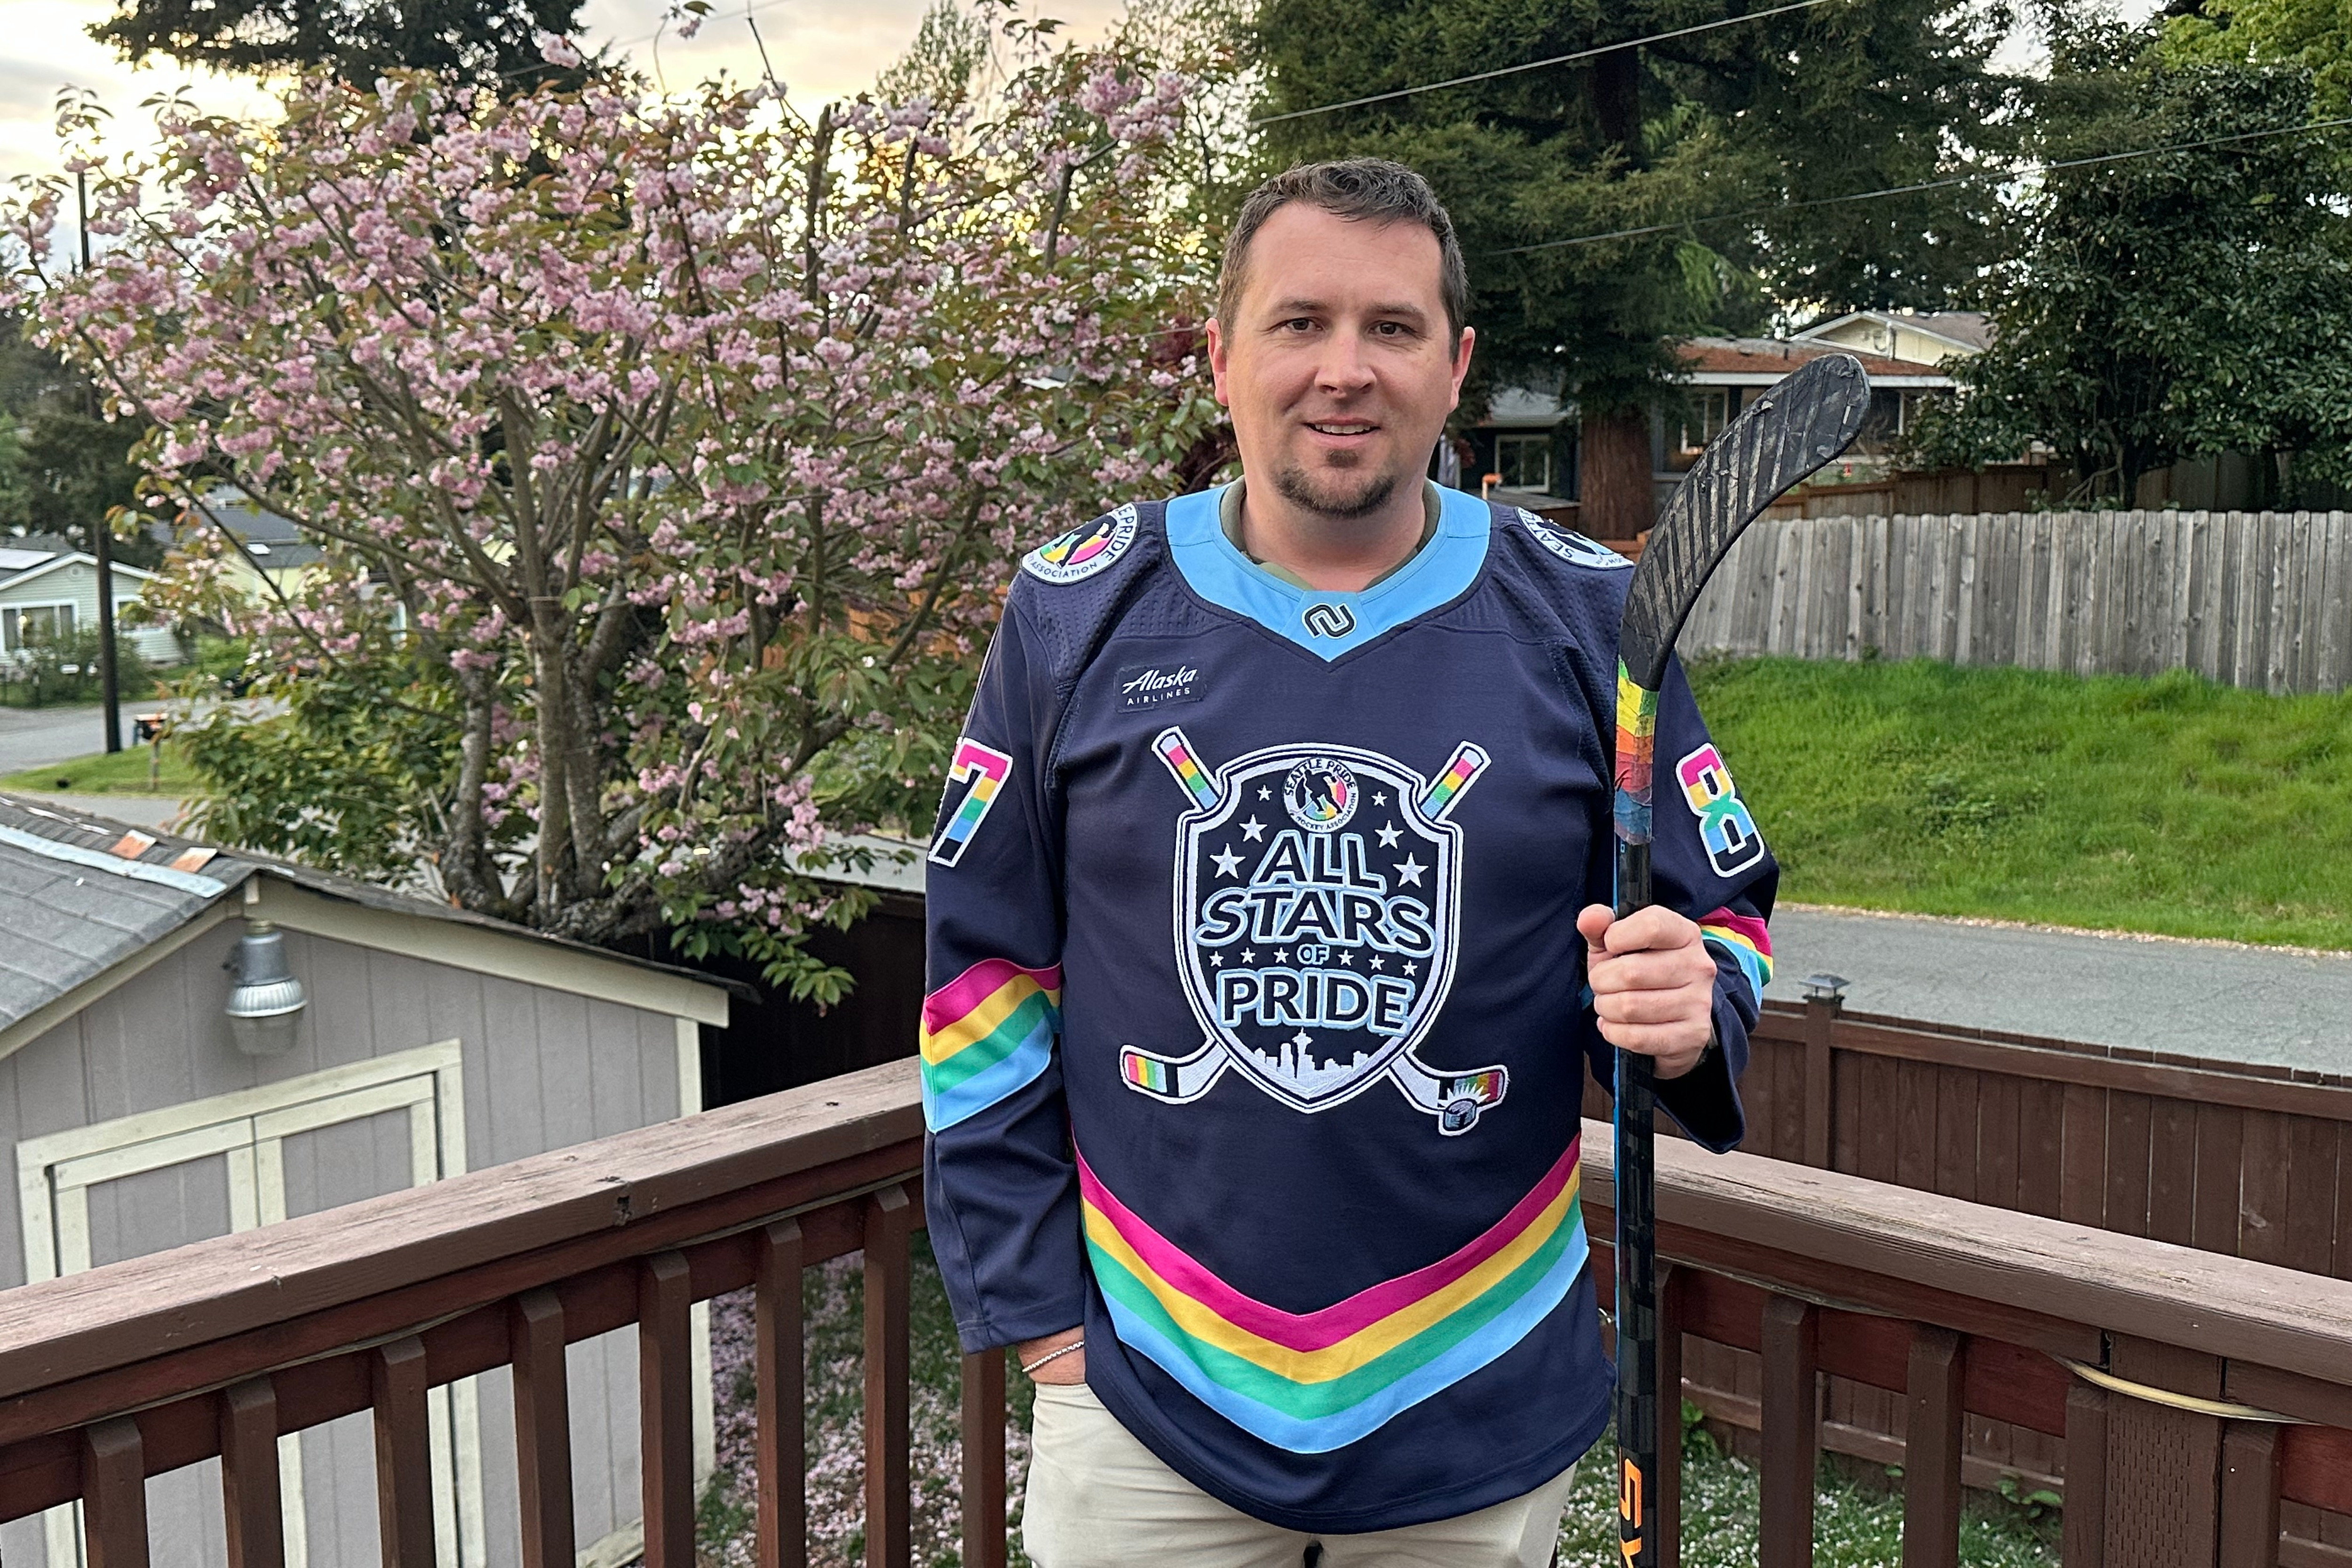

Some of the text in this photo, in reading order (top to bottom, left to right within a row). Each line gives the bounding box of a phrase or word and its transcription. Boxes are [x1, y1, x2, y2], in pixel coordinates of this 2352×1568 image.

[1101, 516, 1135, 561] PRIDE
[1030, 561, 1097, 578] ASSOCIATION
[1122, 665, 1197, 694] Alaska
[1127, 687, 1190, 706] AIRLINES
[1285, 759, 1356, 796] SEATTLE PRIDE
[1296, 793, 1356, 830] HOCKEY ASSOCIATION
[1250, 830, 1387, 894] ALL
[1193, 887, 1436, 958] STARS
[1297, 944, 1329, 965] OF
[1216, 967, 1415, 1035] PRIDE
